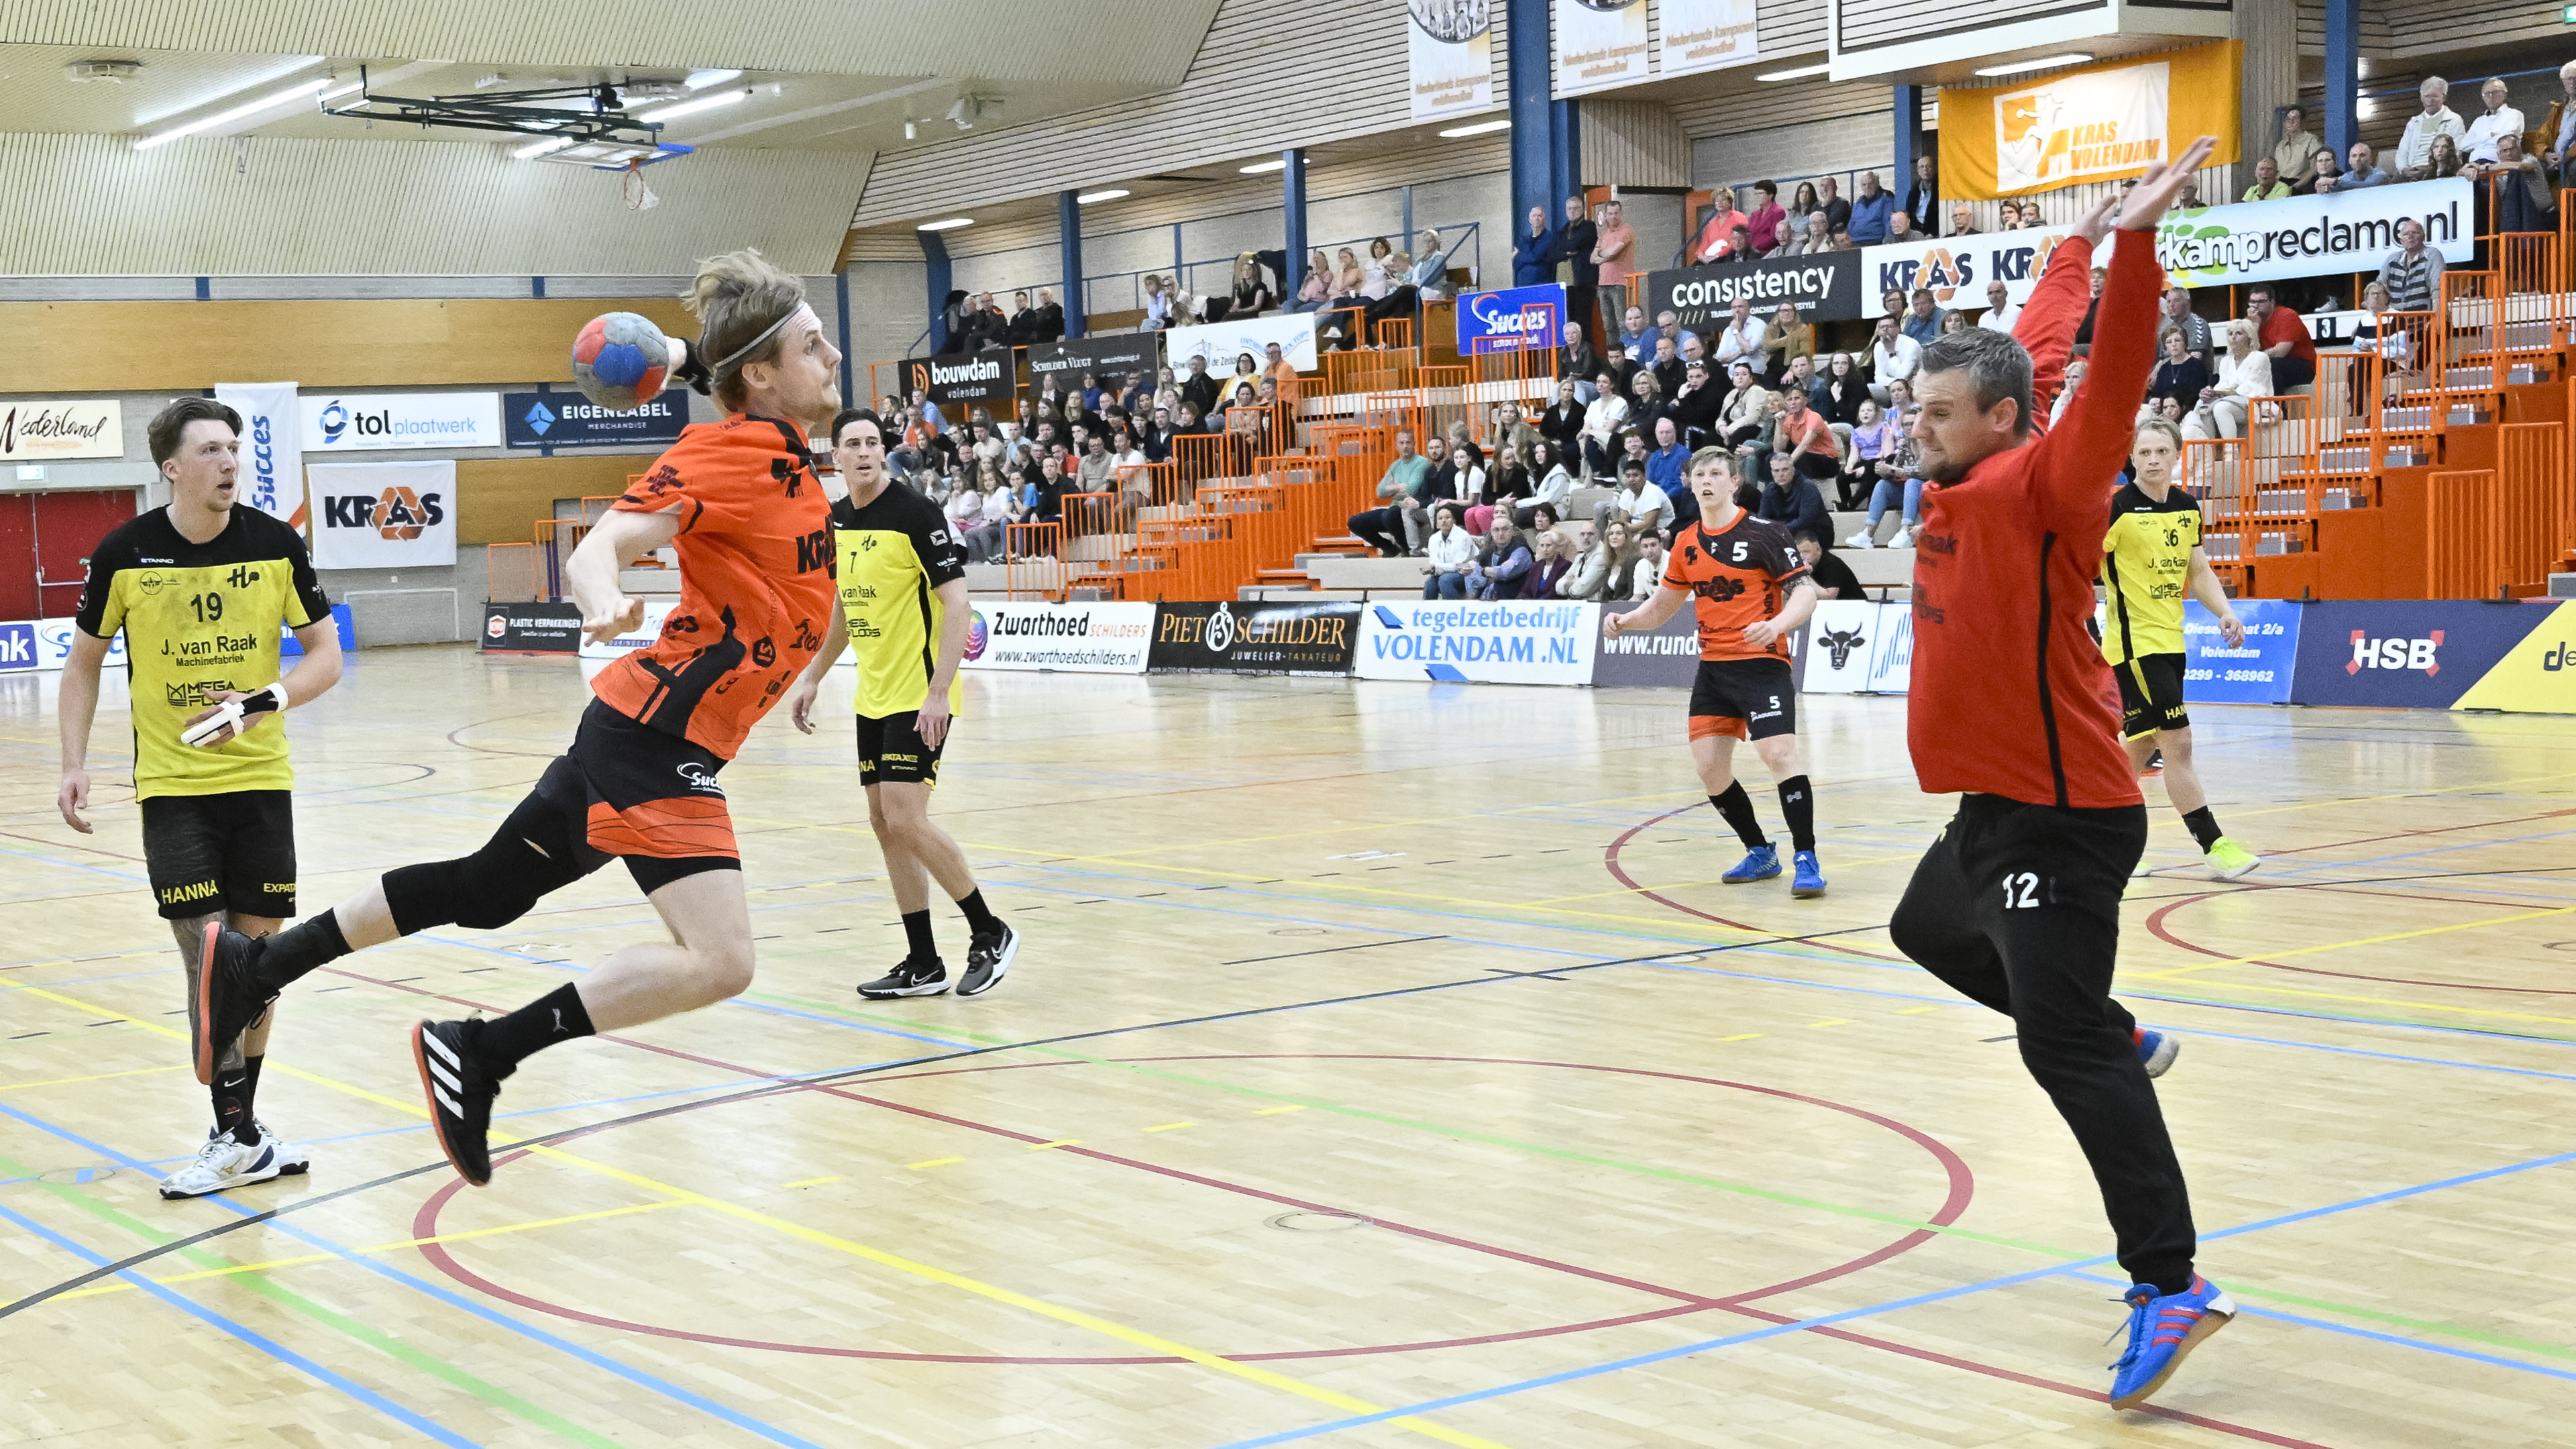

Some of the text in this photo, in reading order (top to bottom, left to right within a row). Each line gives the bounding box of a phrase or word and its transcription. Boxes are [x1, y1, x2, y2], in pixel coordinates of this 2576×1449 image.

[2072, 121, 2118, 146] KRAS
[2070, 138, 2161, 170] VOLENDAM
[1880, 253, 1973, 294] KRAS
[1672, 266, 1835, 308] consistency
[1486, 310, 1546, 335] Succes
[2321, 318, 2331, 338] 3
[931, 357, 1000, 385] bouwdam
[947, 386, 987, 398] volendam
[561, 402, 672, 419] EIGENLABEL
[0, 406, 107, 454] Nederland
[355, 409, 477, 438] tol plaatwerk
[587, 421, 647, 430] MERCHANDISE
[252, 415, 276, 511] Succes
[325, 492, 444, 529] KRAS
[2162, 528, 2179, 547] 36
[850, 551, 858, 574] 7
[1731, 541, 1749, 562] 5
[190, 592, 223, 623] 19
[1412, 605, 1582, 634] tegelzetbedrijf
[994, 611, 1147, 638] Zwarthoed SCHILDERS
[1158, 612, 1208, 643] PIET
[1234, 615, 1346, 650] SCHILDER
[2261, 623, 2284, 635] 2/a
[160, 633, 258, 656] J. van Raak
[995, 648, 1142, 665] www.zwarthoedschilders.nl
[1230, 651, 1341, 663] JUWELIER TAXATEUR
[1373, 634, 1579, 664] VOLENDAM .NL
[2200, 645, 2261, 659] Volendam
[2353, 638, 2436, 669] HSB
[176, 653, 246, 667] Machinefabriek
[2224, 669, 2274, 683] 368962
[1769, 695, 1781, 710] 5
[2165, 704, 2187, 720] HAN
[161, 879, 219, 904] HANNA
[2002, 871, 2040, 909] 12
